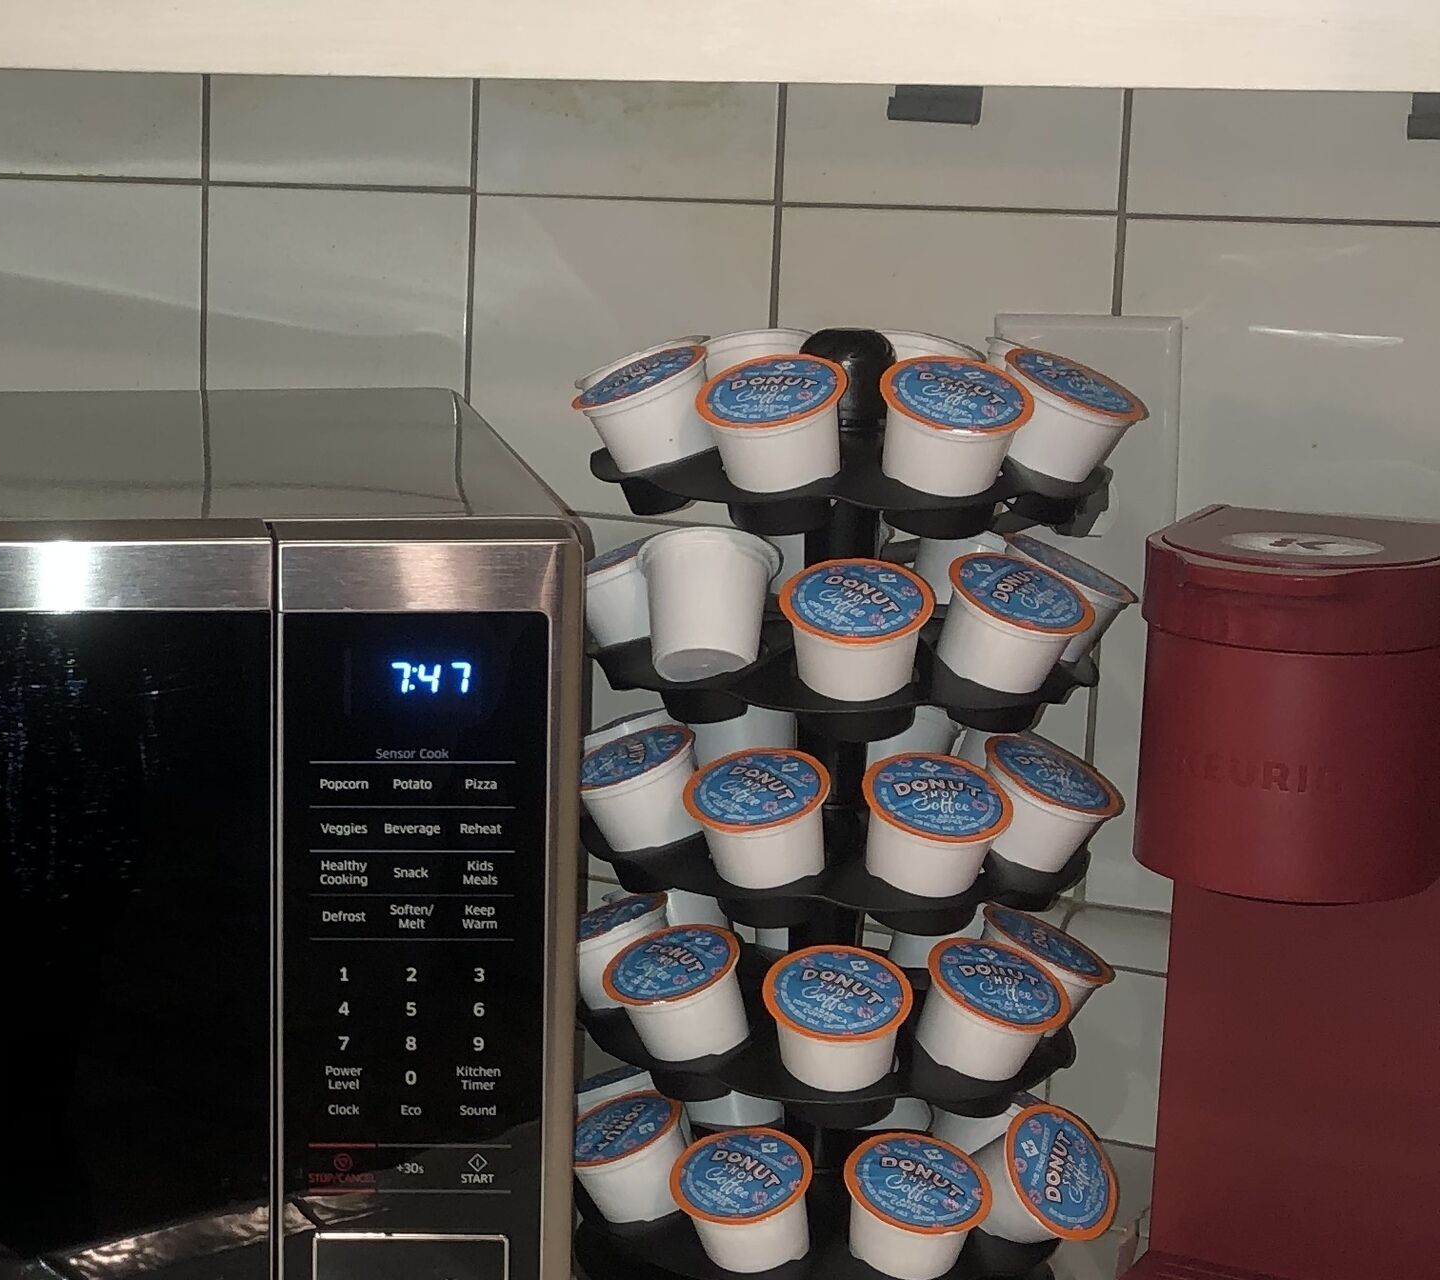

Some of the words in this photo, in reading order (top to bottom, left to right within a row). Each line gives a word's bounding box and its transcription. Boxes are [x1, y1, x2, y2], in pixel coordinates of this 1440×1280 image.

[731, 375, 819, 391] DONUT
[919, 372, 1005, 405] DONUT
[736, 390, 791, 403] Coffee
[922, 384, 977, 410] Coffee
[824, 575, 901, 613] DONUT
[818, 590, 866, 617] Coffee
[392, 662, 471, 694] 7:47
[375, 748, 416, 759] Sensor
[419, 748, 449, 759] Cook
[320, 779, 368, 791] Popcorn
[393, 779, 432, 789] Potato
[465, 779, 497, 789] Pizza
[728, 766, 796, 801] DONUT
[893, 778, 982, 797] DONUT
[921, 790, 960, 800] SHOP
[912, 796, 971, 814] Coffee
[321, 823, 367, 835] Veggies
[385, 823, 440, 835] Beverage
[460, 823, 501, 834] Reheat
[321, 860, 367, 872] Healthy
[394, 867, 428, 878] Snack
[468, 861, 493, 871] Kids
[320, 874, 368, 887] Cooking
[463, 875, 498, 885] Meals
[323, 911, 366, 922] Defrost
[390, 904, 433, 916] Soften/
[465, 905, 495, 917] Keep
[399, 919, 425, 929] Melt
[462, 919, 498, 930] Warm
[644, 944, 705, 972] DONUT
[340, 967, 348, 981] 1
[407, 968, 417, 981] 2
[475, 968, 484, 982] 3
[801, 969, 885, 1005] DONUT
[819, 981, 854, 1000] SHOP
[980, 981, 1033, 1001] Coffee
[801, 986, 854, 1013] Coffee
[339, 1002, 349, 1015] 4
[407, 1002, 416, 1016] 5
[474, 1002, 484, 1016] 6
[339, 1036, 349, 1050] 7
[406, 1036, 416, 1050] 8
[473, 1037, 484, 1051] 9
[325, 1066, 362, 1077] Power
[406, 1071, 416, 1085] 0
[456, 1066, 501, 1078] Kitchen
[329, 1079, 359, 1089] Level
[461, 1080, 495, 1090] Timer
[328, 1104, 359, 1115] Clock
[401, 1105, 421, 1115] Eco
[460, 1105, 496, 1115] Sound
[396, 1163, 424, 1174] +30s
[710, 1150, 782, 1188] DONUT
[723, 1163, 754, 1183] SHOP
[1045, 1129, 1072, 1204] DONUT
[1062, 1155, 1075, 1185] SHOP
[309, 1173, 376, 1183] STOP/CANCEL
[461, 1174, 494, 1184] START
[880, 1156, 965, 1197] DONUT
[1068, 1158, 1090, 1203] Coffee
[705, 1167, 749, 1200] Coffee
[885, 1174, 939, 1206] Coffee
